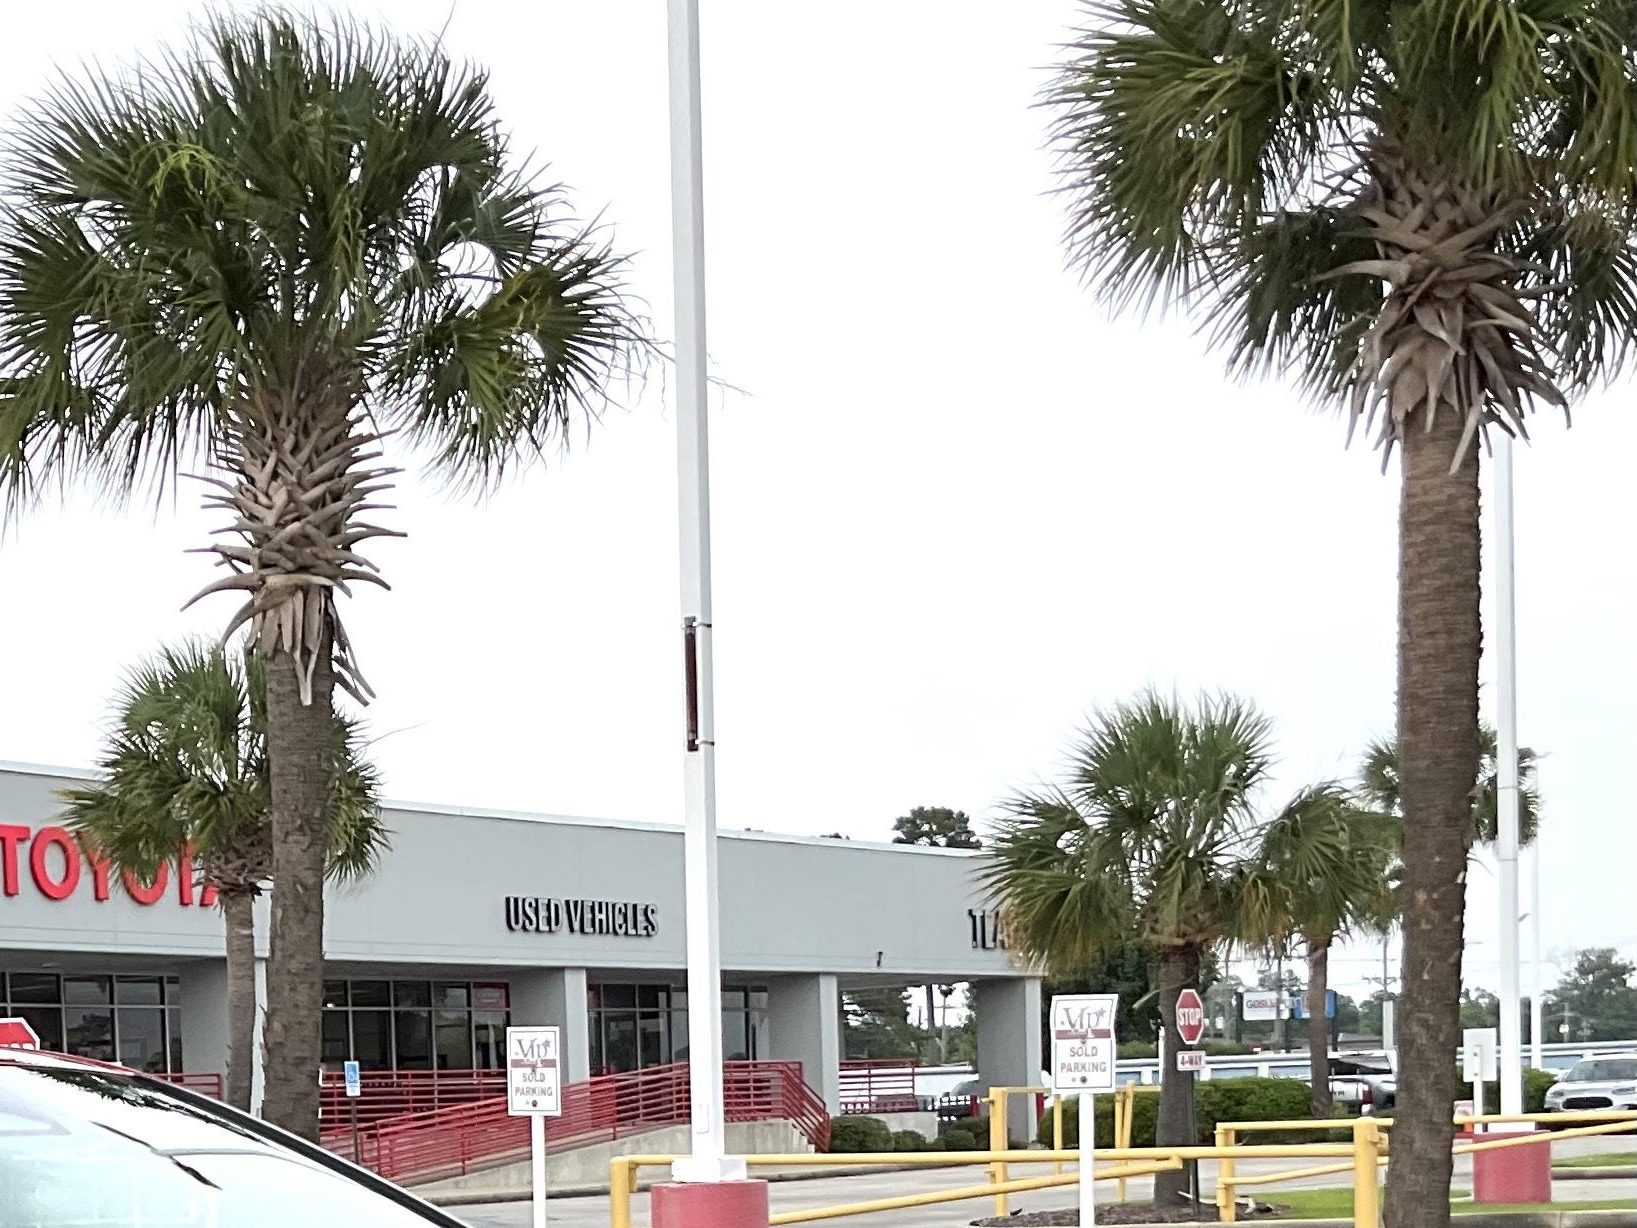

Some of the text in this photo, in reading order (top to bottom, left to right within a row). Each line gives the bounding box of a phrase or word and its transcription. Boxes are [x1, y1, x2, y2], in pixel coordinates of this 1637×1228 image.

[505, 896, 659, 937] USED VEHICLES
[1178, 1008, 1201, 1026] STOP
[1069, 1046, 1098, 1057] SOLD
[1060, 1062, 1107, 1073] PARKING
[522, 1072, 546, 1083] SOLD
[514, 1087, 553, 1097] PARKING
